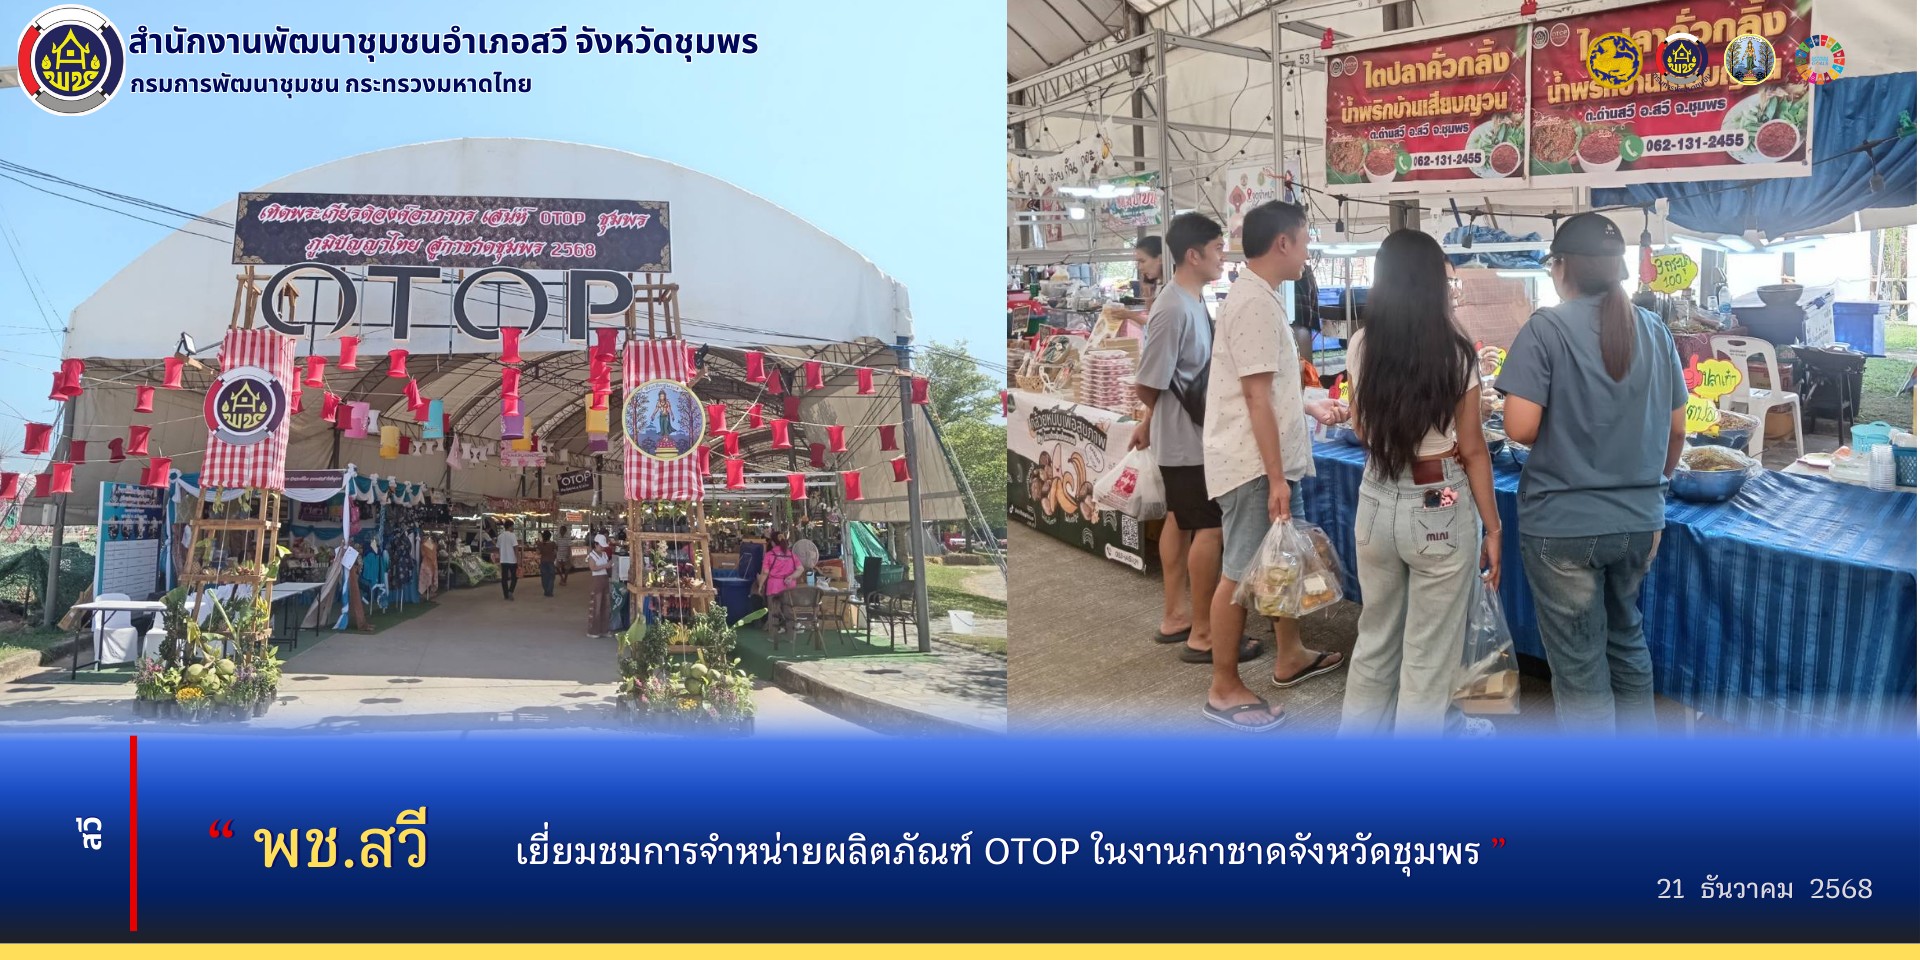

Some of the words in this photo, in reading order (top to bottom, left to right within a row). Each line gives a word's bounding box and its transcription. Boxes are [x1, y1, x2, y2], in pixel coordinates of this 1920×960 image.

[1299, 54, 1310, 65] 53
[1585, 104, 1636, 122] ต.ด่านสวี
[1640, 101, 1670, 118] อ.สวี
[1675, 98, 1727, 117] จ.ชุมพร
[1369, 124, 1406, 141] ต.ด่านสวี
[1408, 123, 1430, 138] อ.สวี
[1432, 122, 1469, 140] จ.ชุมพร
[1646, 133, 1745, 153] 062-131-2455
[1413, 151, 1482, 167] 062-131-2455
[539, 210, 586, 226] OTOP
[597, 208, 650, 237] ชุมพร
[305, 230, 425, 260] ภูมิปัญญาไทย
[550, 242, 596, 258] 2568
[1654, 257, 1664, 276] 3
[261, 261, 635, 343] OTOP
[561, 470, 592, 487] OTOP
